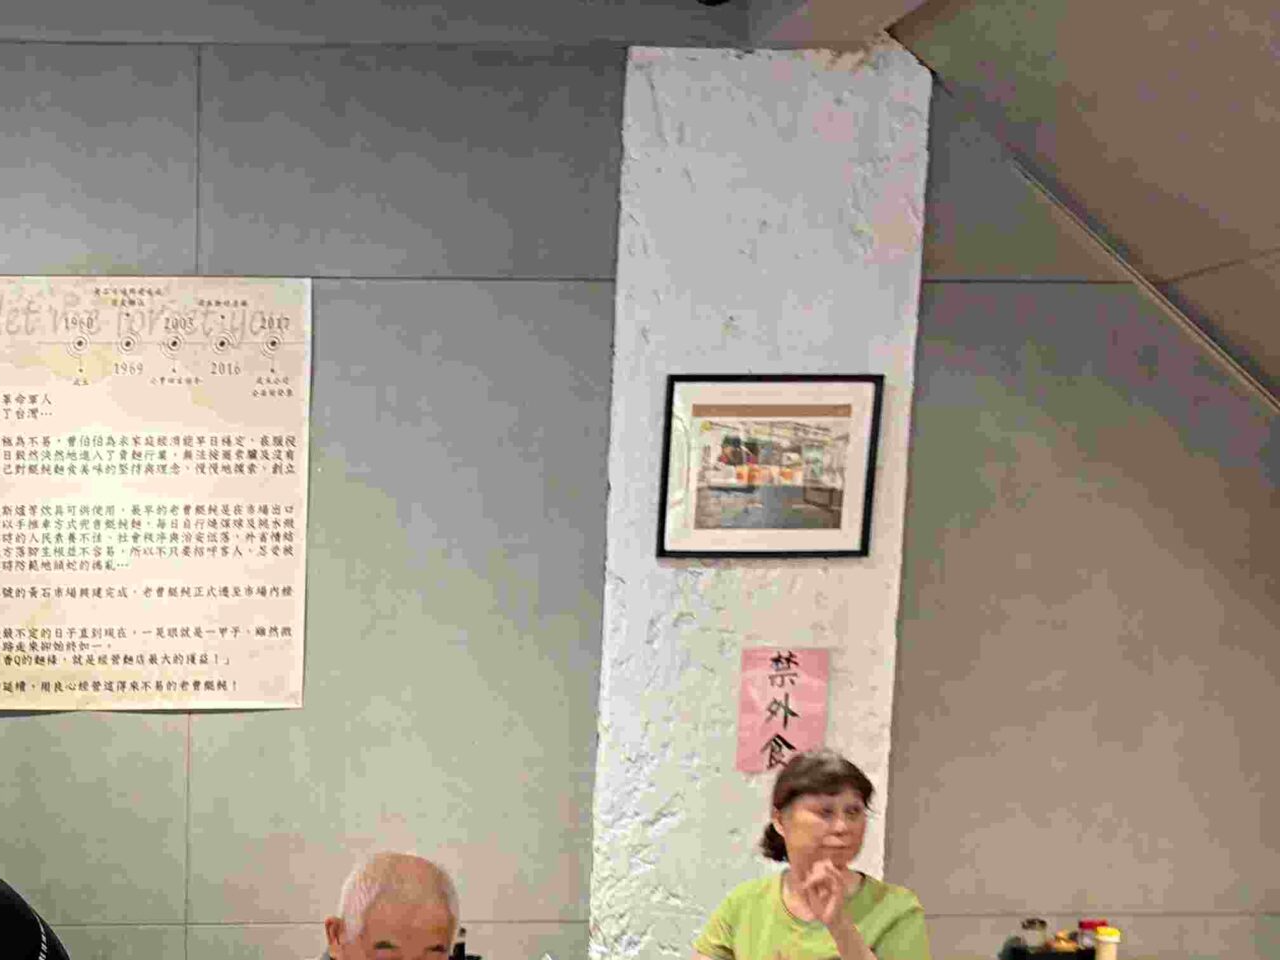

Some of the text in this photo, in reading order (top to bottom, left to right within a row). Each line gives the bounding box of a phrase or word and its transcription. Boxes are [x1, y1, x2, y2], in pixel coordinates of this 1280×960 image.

[113, 362, 144, 376] 1969
[210, 361, 242, 376] 2016
[760, 650, 801, 770] 禁外食
